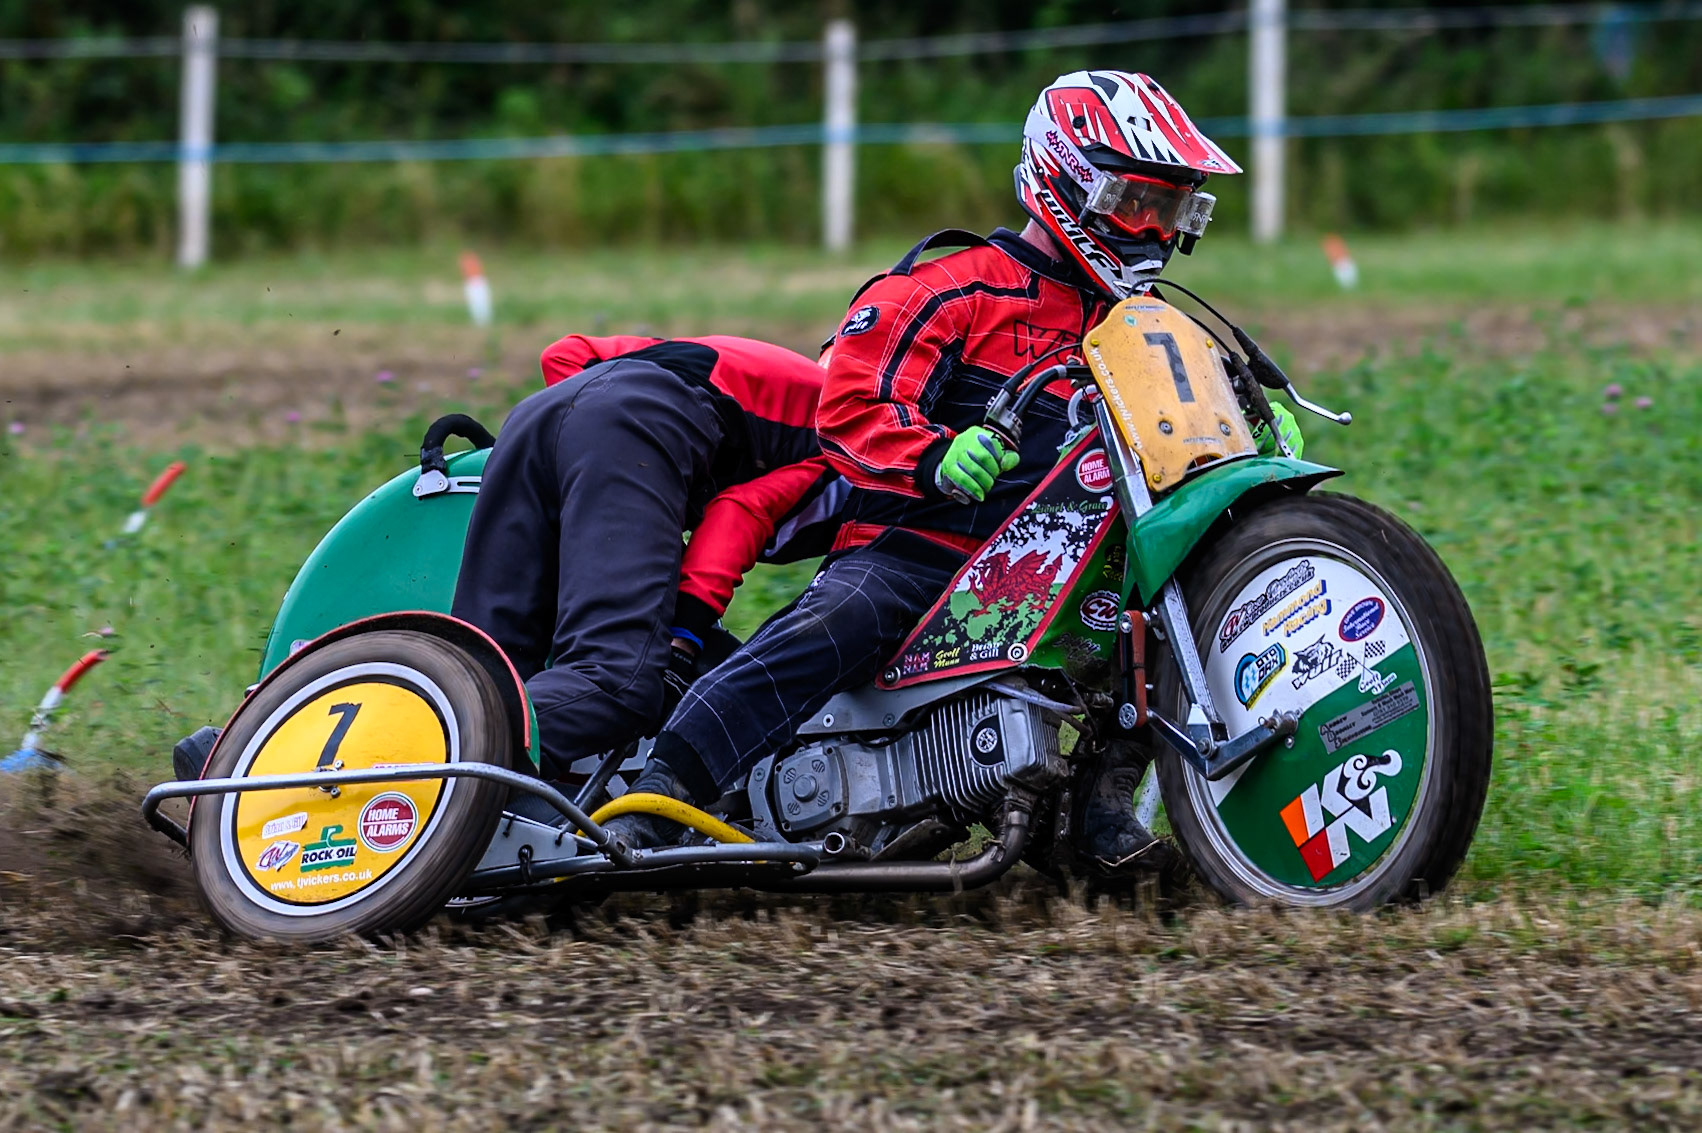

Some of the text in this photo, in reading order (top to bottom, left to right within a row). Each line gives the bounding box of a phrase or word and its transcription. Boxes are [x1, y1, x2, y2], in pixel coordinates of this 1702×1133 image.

[1143, 332, 1195, 403] 7
[1081, 458, 1105, 473] HOME
[317, 702, 362, 767] 7
[367, 808, 400, 822] HOME
[1280, 749, 1403, 883] K&N
[366, 823, 409, 837] ALARMS
[301, 849, 334, 864] ROCK
[336, 846, 356, 858] OIL
